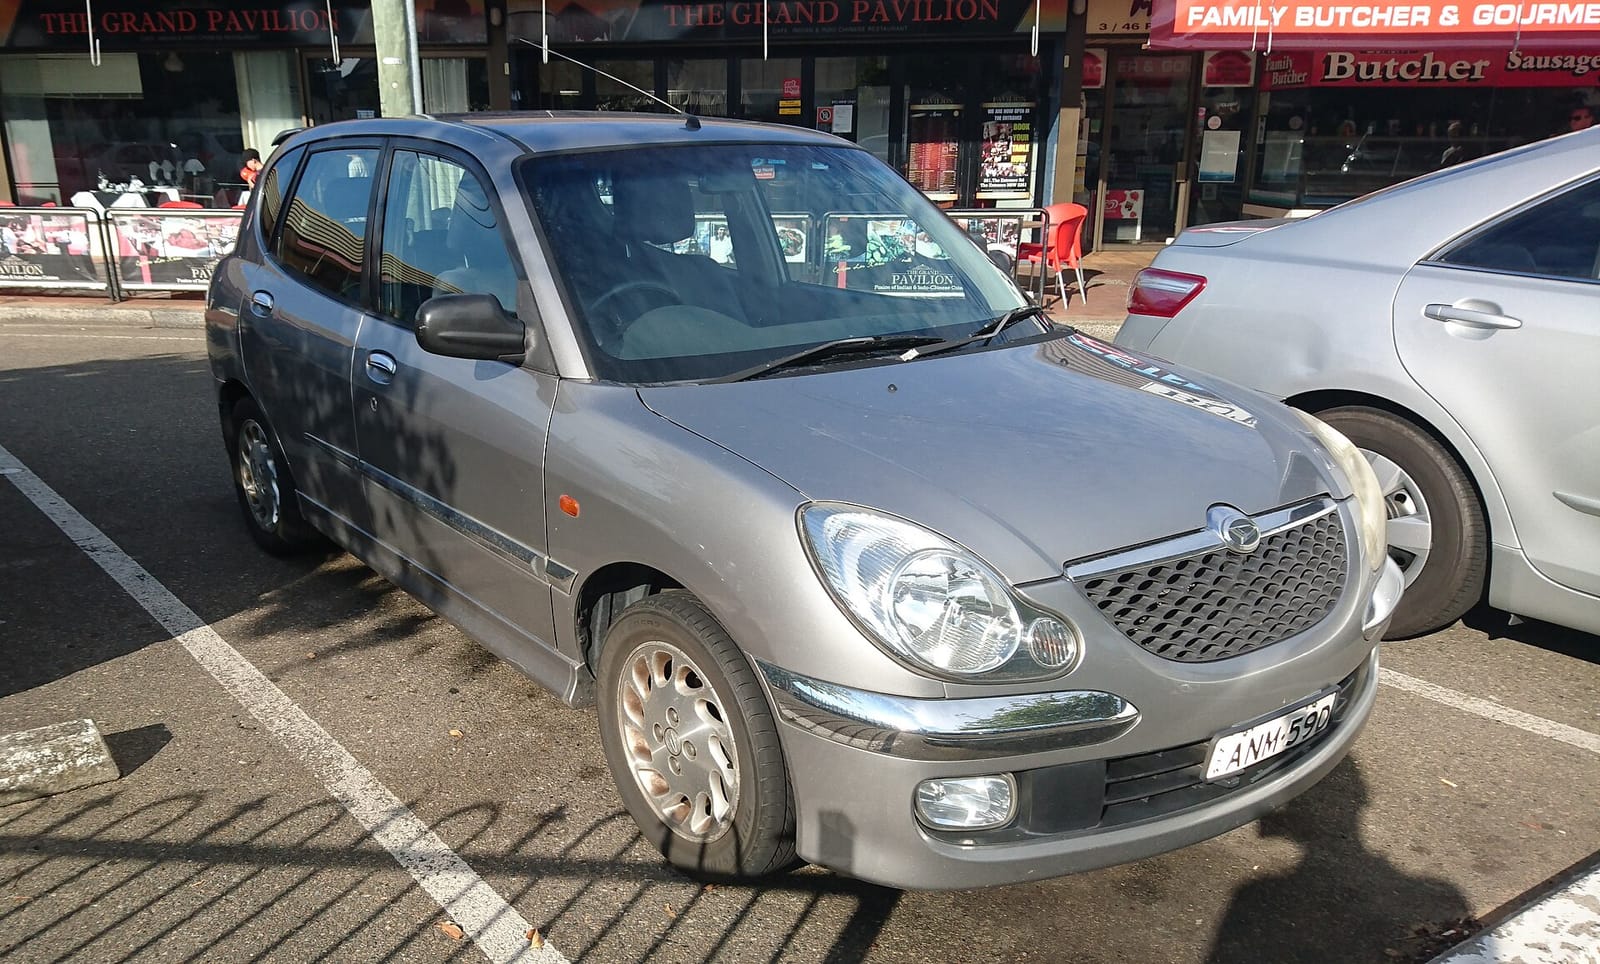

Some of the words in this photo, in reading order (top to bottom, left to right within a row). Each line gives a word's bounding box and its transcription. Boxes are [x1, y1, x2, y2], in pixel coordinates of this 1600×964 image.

[40, 13, 97, 34] THE
[102, 11, 197, 33] GRAND
[207, 9, 340, 32] PAVILION
[664, 4, 726, 26] THE
[730, 2, 839, 25] GRAND
[851, 0, 999, 23] PAVILION
[1188, 6, 1288, 27] FAMILY
[1295, 6, 1431, 27] BUTCHER
[1439, 6, 1460, 26] &
[1099, 23, 1107, 31] 3
[1122, 23, 1140, 31] 46
[1265, 56, 1294, 72] Family
[1323, 51, 1491, 82] Butcher
[1507, 51, 1600, 74] Sausage
[1272, 69, 1307, 85] Butcher
[892, 275, 954, 285] PAVILION
